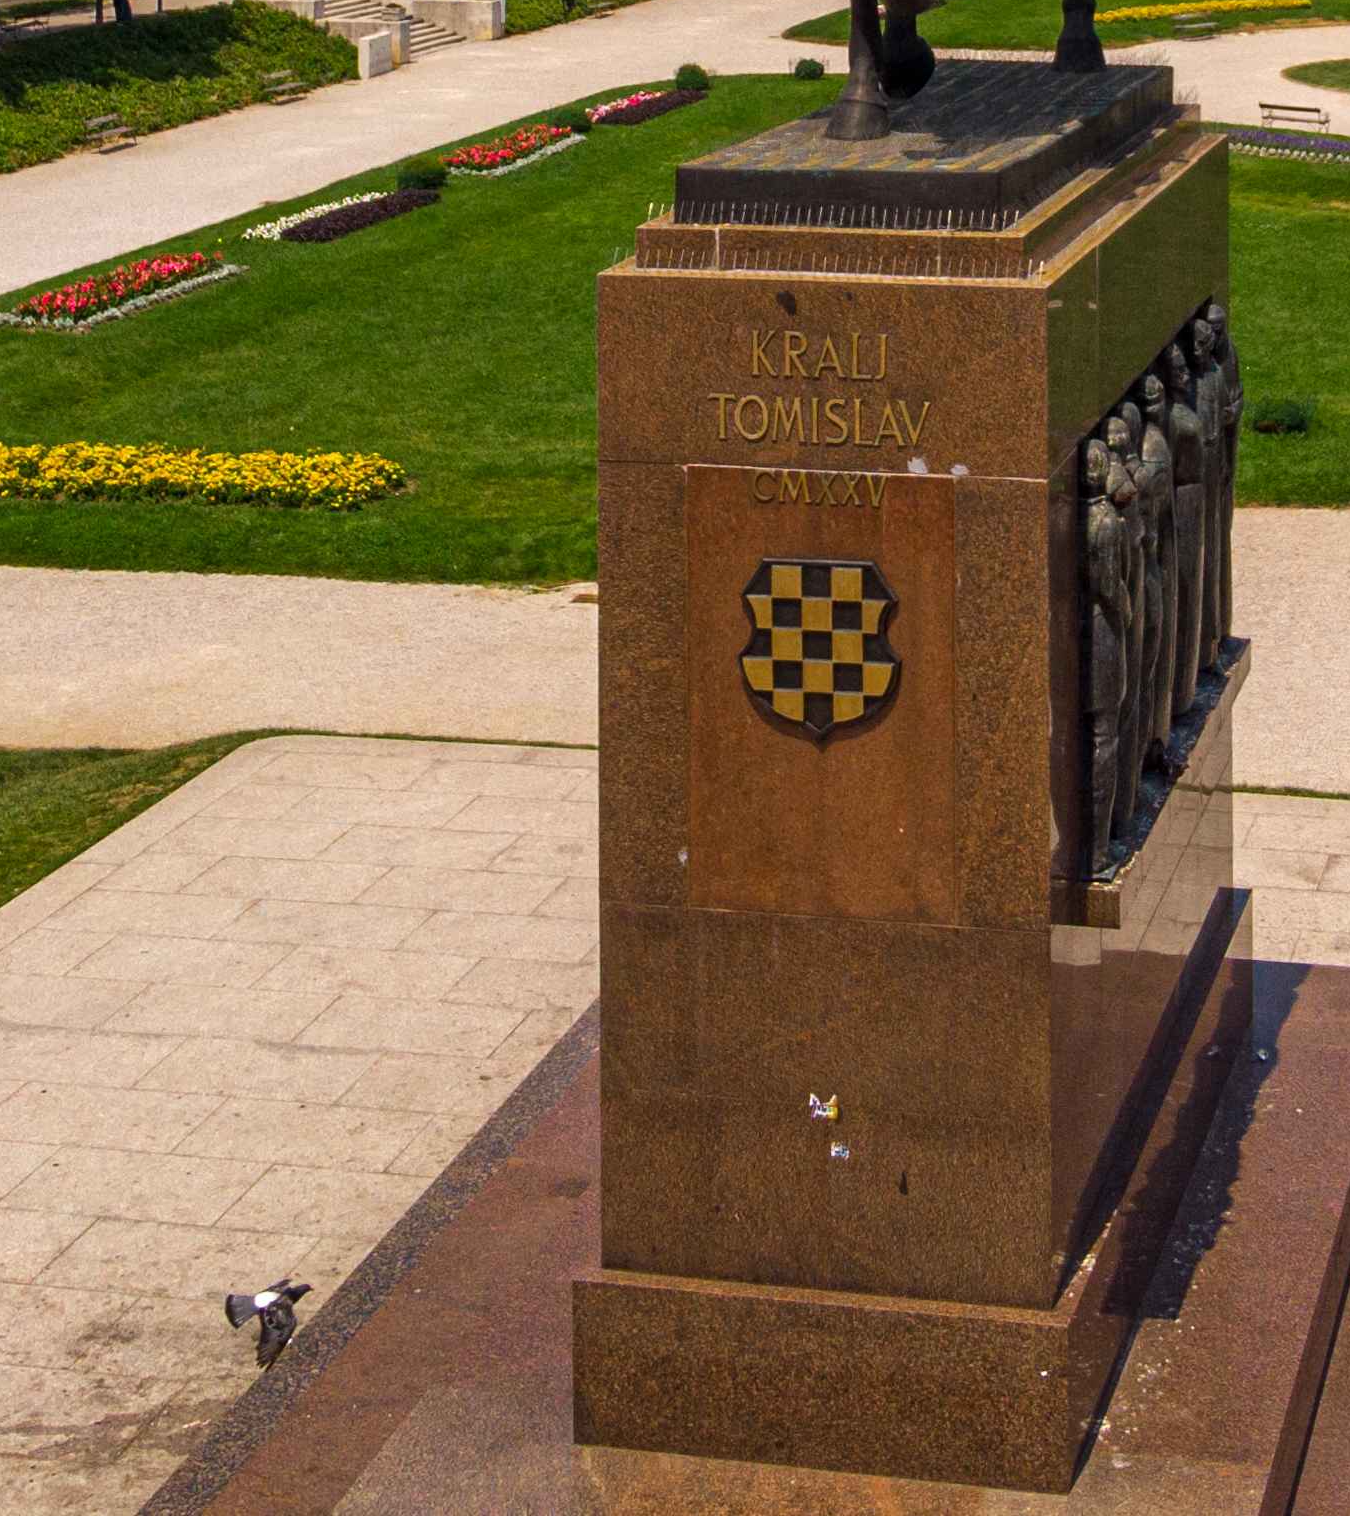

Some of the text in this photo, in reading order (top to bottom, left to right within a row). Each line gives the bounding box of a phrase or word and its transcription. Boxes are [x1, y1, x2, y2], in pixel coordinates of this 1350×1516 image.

[751, 329, 889, 381] KRALJ
[707, 392, 931, 448] TOMISLAV
[753, 471, 890, 509] CMXXV
